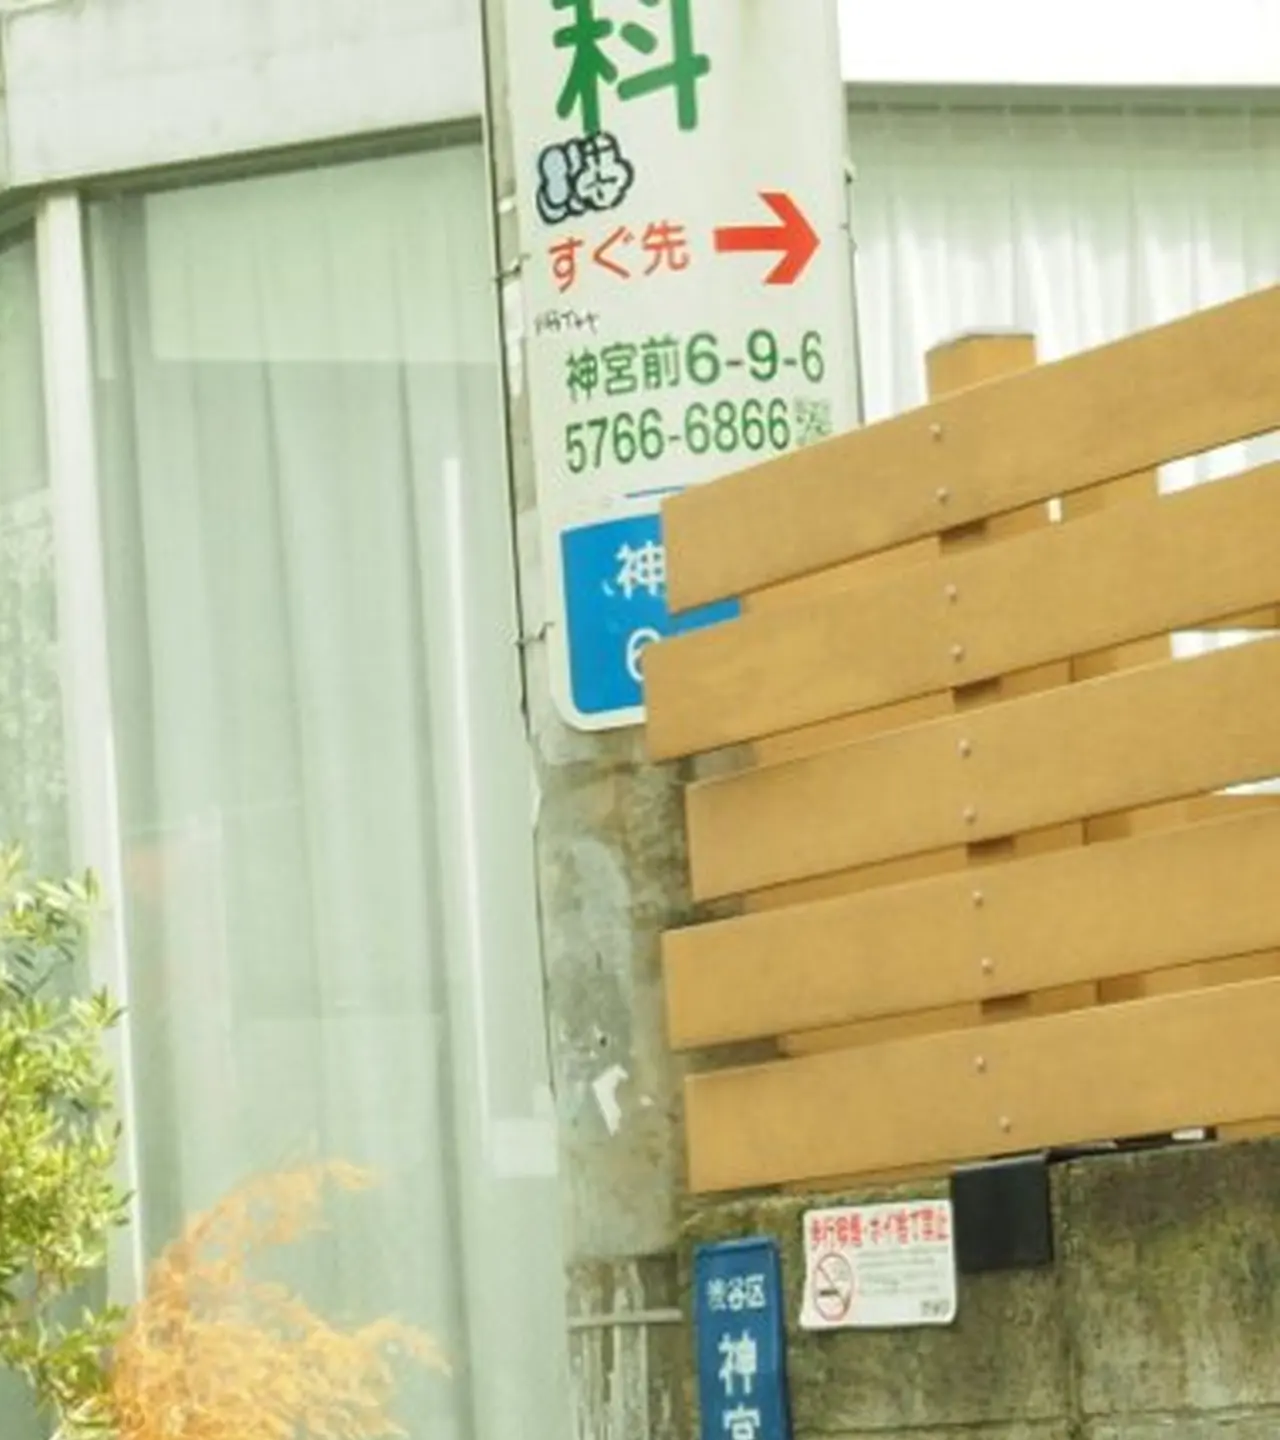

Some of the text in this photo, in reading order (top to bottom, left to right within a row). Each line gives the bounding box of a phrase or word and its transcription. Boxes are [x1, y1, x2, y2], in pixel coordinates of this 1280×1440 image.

[551, 0, 711, 135] 科
[549, 220, 690, 292] すぐ先
[565, 329, 825, 403] 神宮前6-9-6
[565, 397, 791, 474] 5766-6866
